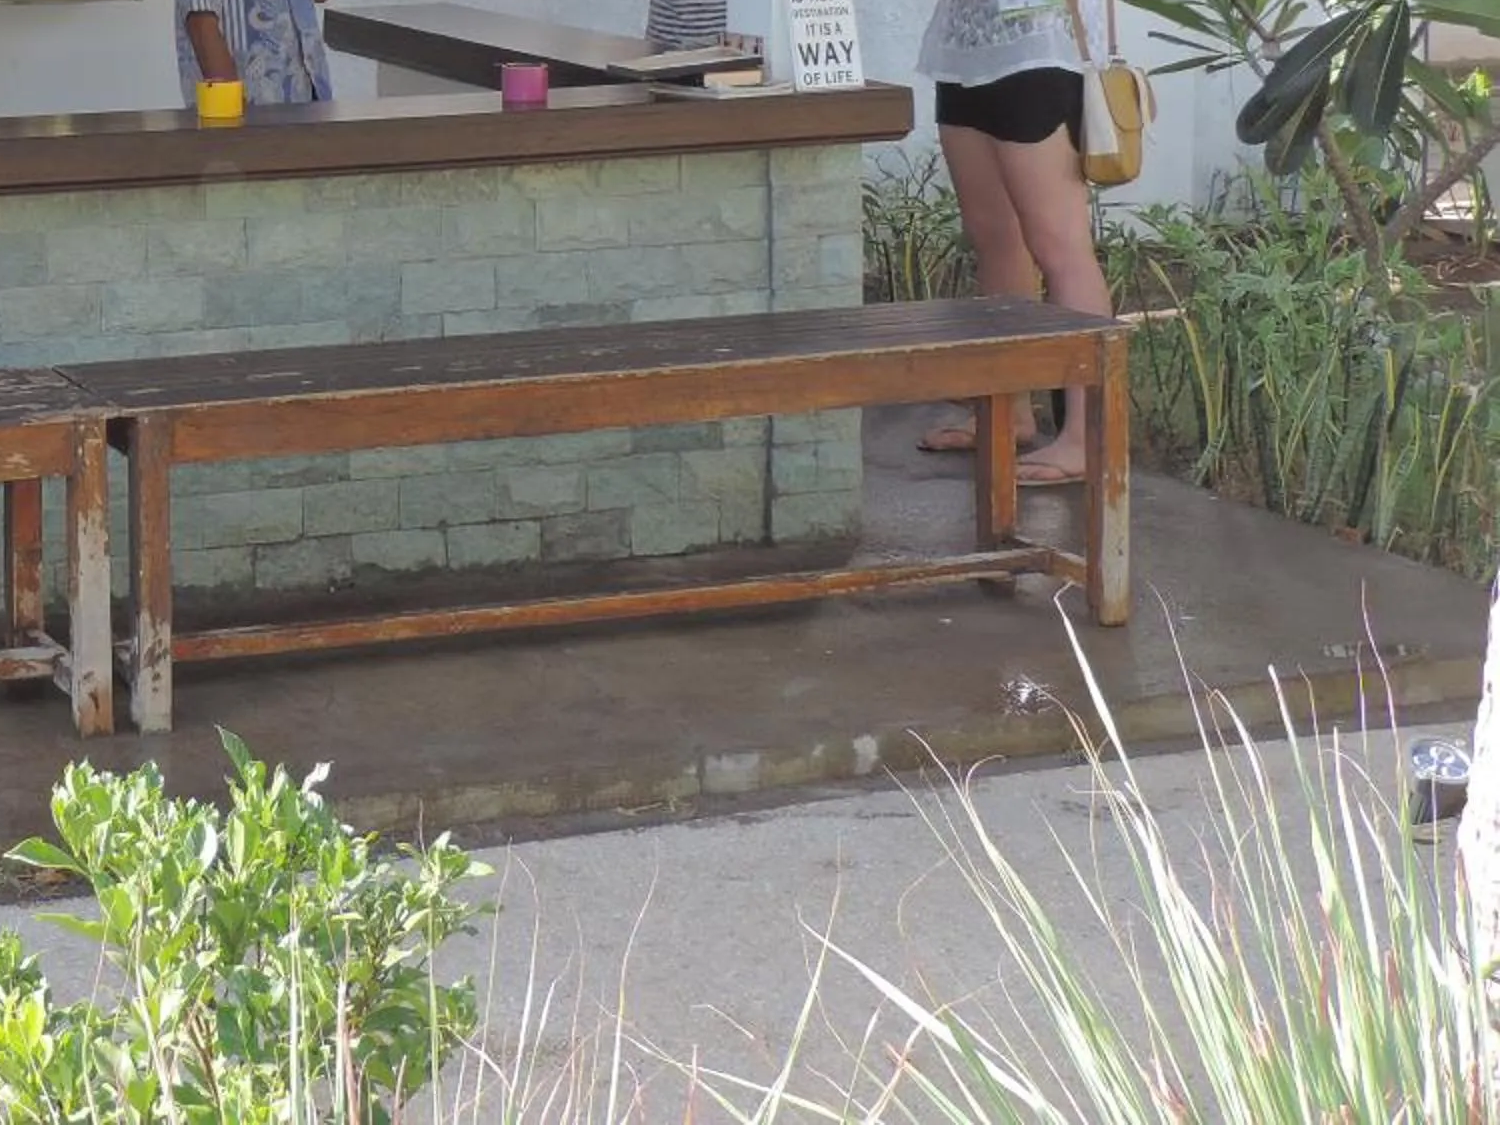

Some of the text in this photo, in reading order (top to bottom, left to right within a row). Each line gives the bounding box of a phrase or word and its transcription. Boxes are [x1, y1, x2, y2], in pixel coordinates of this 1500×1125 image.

[805, 22, 843, 37] IT IS A
[798, 40, 854, 67] WAY
[803, 73, 821, 86] OF
